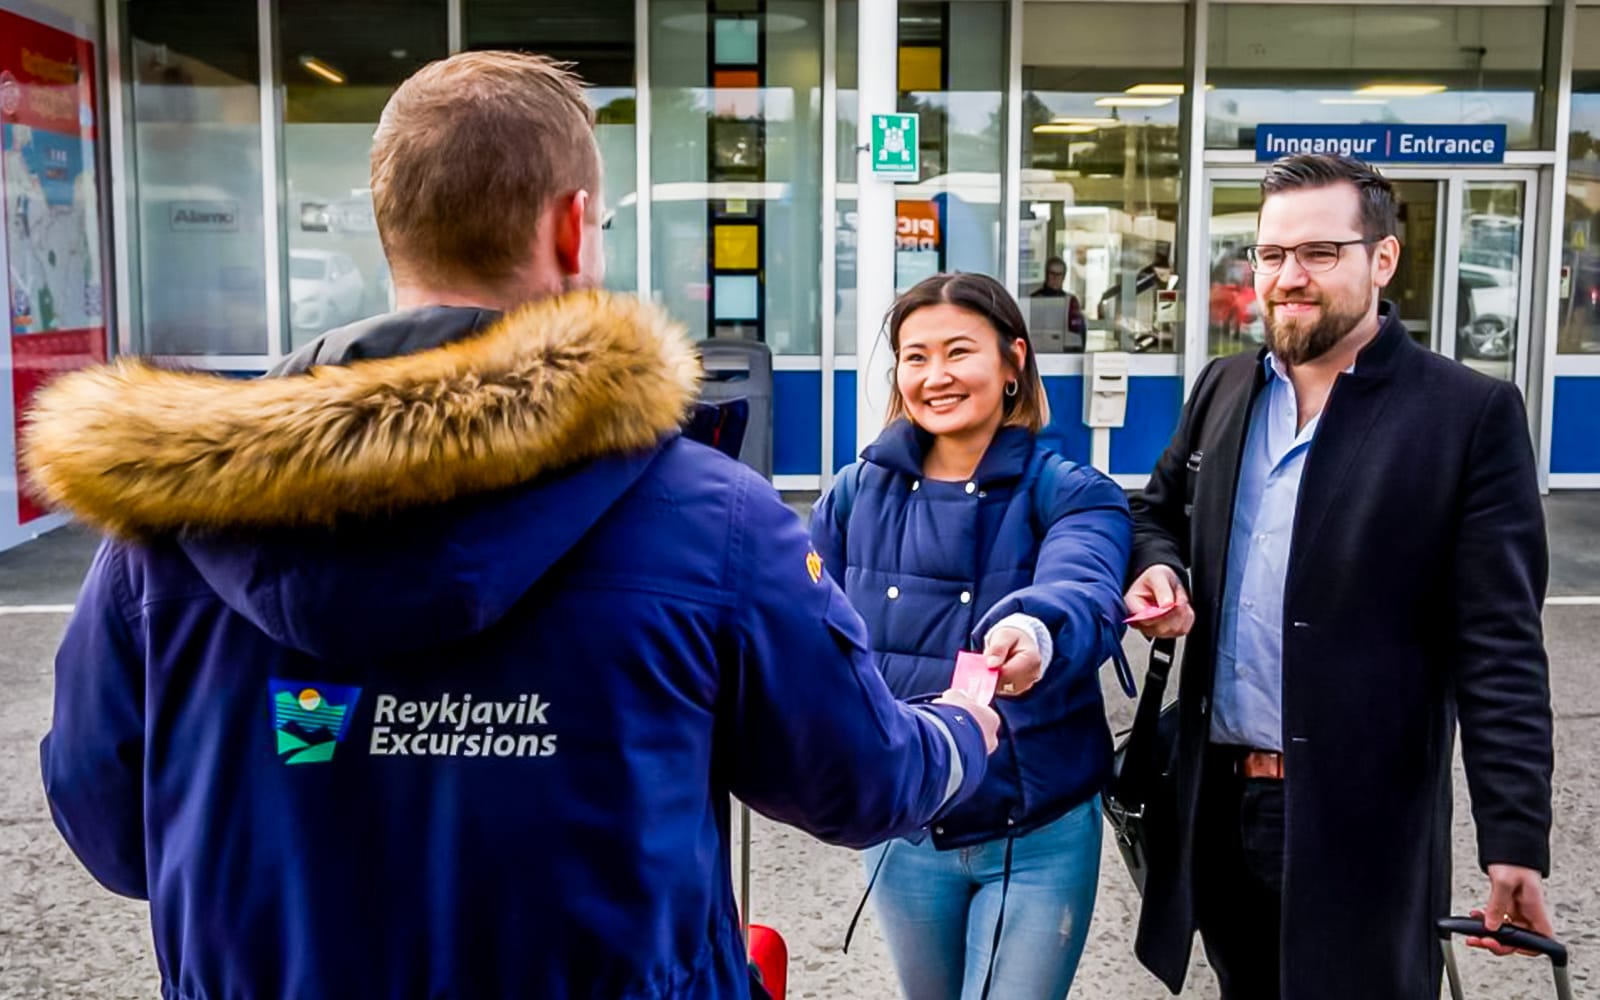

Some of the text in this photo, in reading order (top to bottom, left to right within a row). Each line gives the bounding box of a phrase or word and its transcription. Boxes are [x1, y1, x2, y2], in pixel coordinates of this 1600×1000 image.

[1266, 133, 1495, 156] Inngangur Entrance
[374, 693, 551, 732] Reykjavik
[369, 726, 558, 757] Excursions
